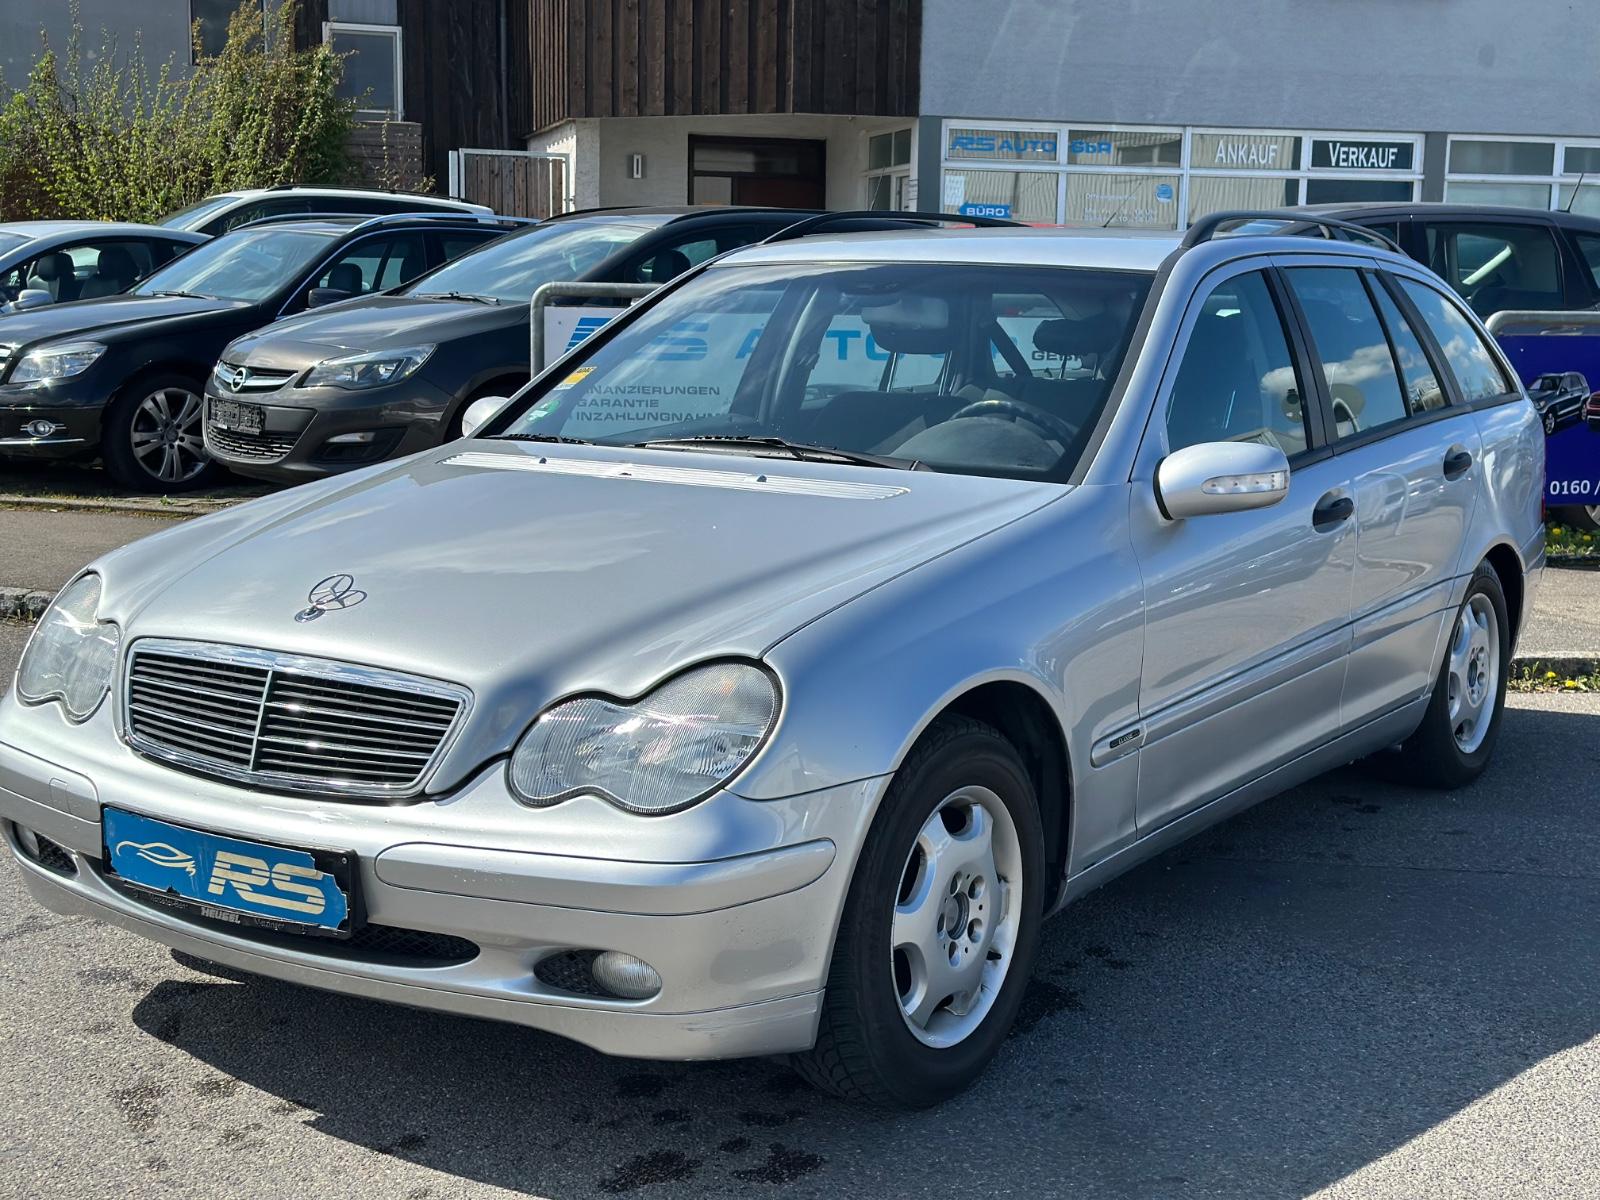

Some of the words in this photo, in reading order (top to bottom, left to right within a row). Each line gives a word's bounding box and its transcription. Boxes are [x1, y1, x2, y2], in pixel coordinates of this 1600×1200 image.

[999, 139, 1056, 153] AUTO
[1215, 140, 1277, 164] ANKAUF
[1328, 143, 1397, 168] VERKAUF
[966, 206, 1005, 216] BÜRO
[577, 399, 659, 408] GARANTIE
[1550, 480, 1590, 495] 0160
[207, 851, 326, 915] RS
